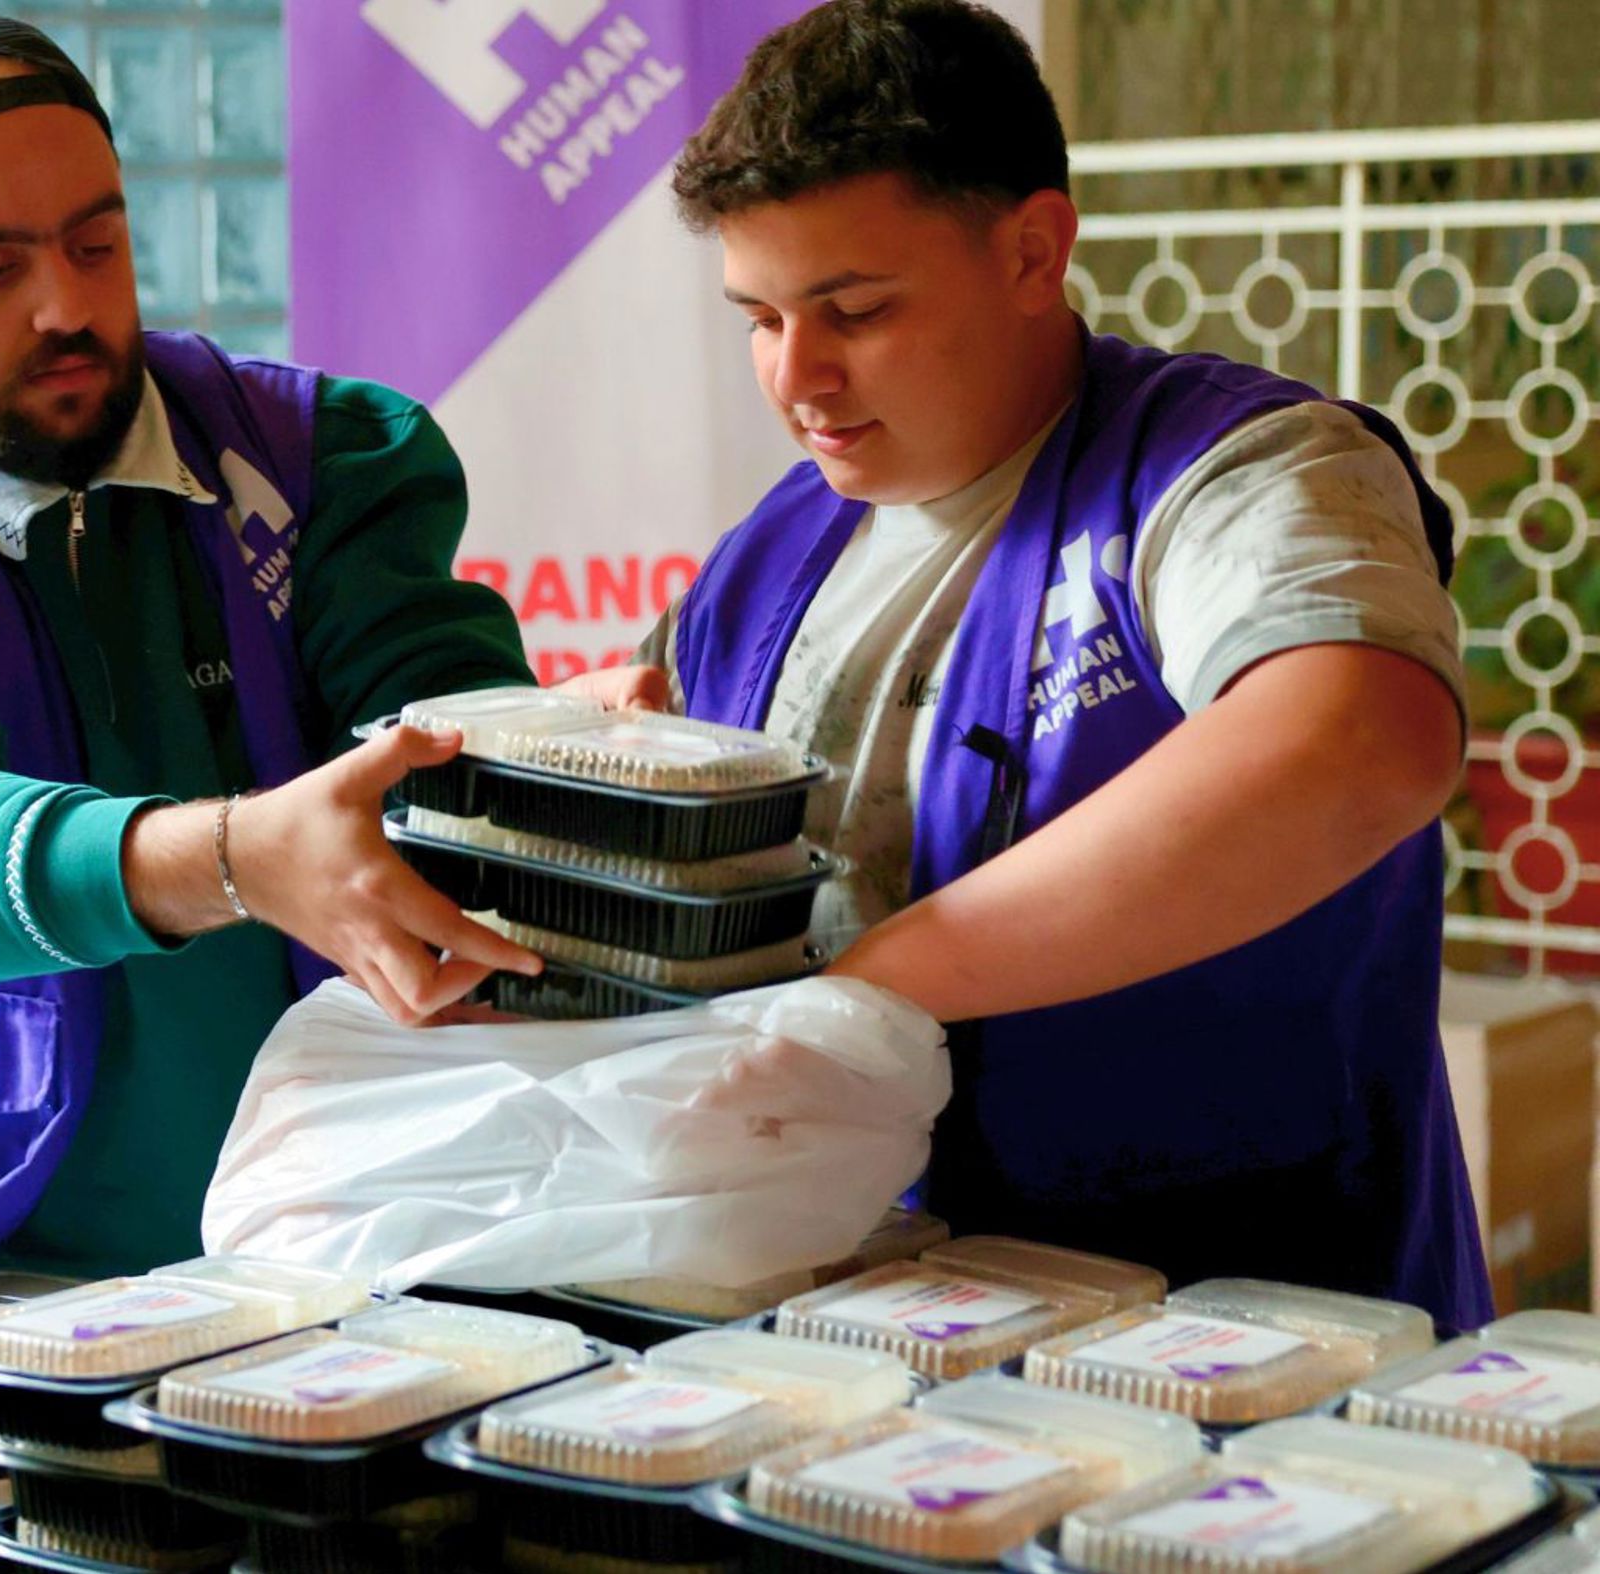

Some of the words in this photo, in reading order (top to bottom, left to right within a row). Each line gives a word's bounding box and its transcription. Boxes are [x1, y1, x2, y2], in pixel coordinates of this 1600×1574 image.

[499, 13, 649, 170] HUMAN
[539, 56, 685, 205] APPEAL
[1027, 633, 1123, 711] HUMAN
[1033, 667, 1137, 741] APPEAL
